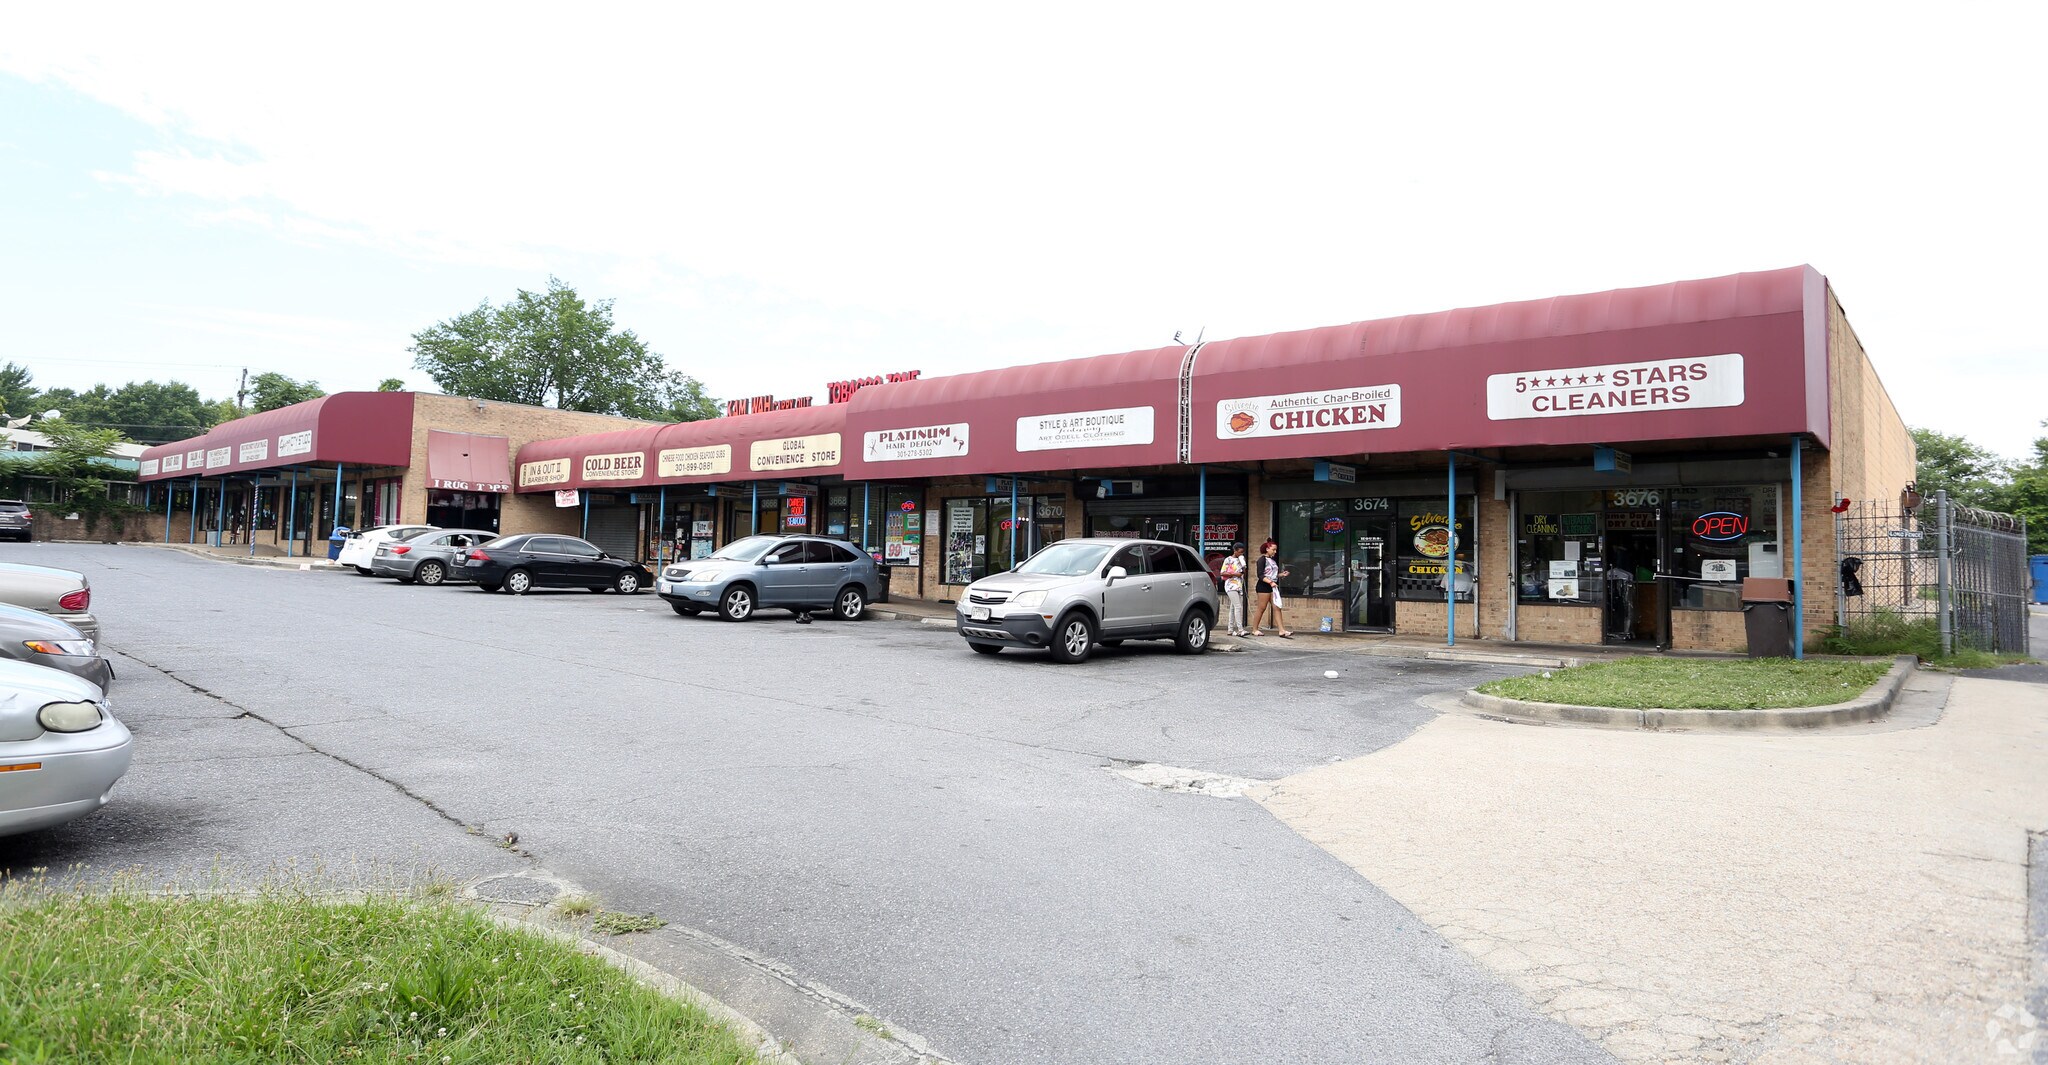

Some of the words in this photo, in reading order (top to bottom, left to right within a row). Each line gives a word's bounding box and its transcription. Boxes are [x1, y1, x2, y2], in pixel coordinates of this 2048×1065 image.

[1612, 363, 1708, 387] STARS
[1270, 396, 1319, 408] Authentic
[1323, 389, 1391, 404] Char-Broiled
[1531, 385, 1691, 412] CLEANERS
[728, 398, 749, 417] KAM
[751, 395, 774, 414] WAH
[796, 396, 813, 409] OUT
[1039, 420, 1061, 430] STYLE
[1062, 420, 1068, 429] &
[1070, 418, 1084, 428] ART
[1086, 415, 1124, 426] BOUTIQUE
[1269, 404, 1387, 431] CHICKEN
[879, 427, 951, 442] PLATINUM
[782, 440, 805, 450] GLOBAL
[910, 439, 942, 448] DESIGNS
[585, 458, 611, 470] COLD
[613, 456, 642, 469] BEER
[757, 454, 804, 466] CONVENIENCE
[811, 451, 836, 461] STORE
[529, 466, 536, 475] IN
[537, 465, 541, 475] &
[543, 463, 556, 474] OUT
[585, 470, 619, 478] CONVENIENCE
[527, 475, 549, 484] BARBER
[829, 496, 847, 506] 3668
[1354, 498, 1389, 510] 3674
[1613, 491, 1660, 506] 3676
[901, 502, 916, 510] OPEN
[1039, 506, 1063, 516] 3670
[1410, 512, 1463, 531] Silvese
[1534, 515, 1547, 525] DRY
[1607, 520, 1626, 528] DRY
[1692, 516, 1749, 536] OPEN
[1526, 524, 1558, 534] CLEANING
[1408, 565, 1463, 575] CHICKN
